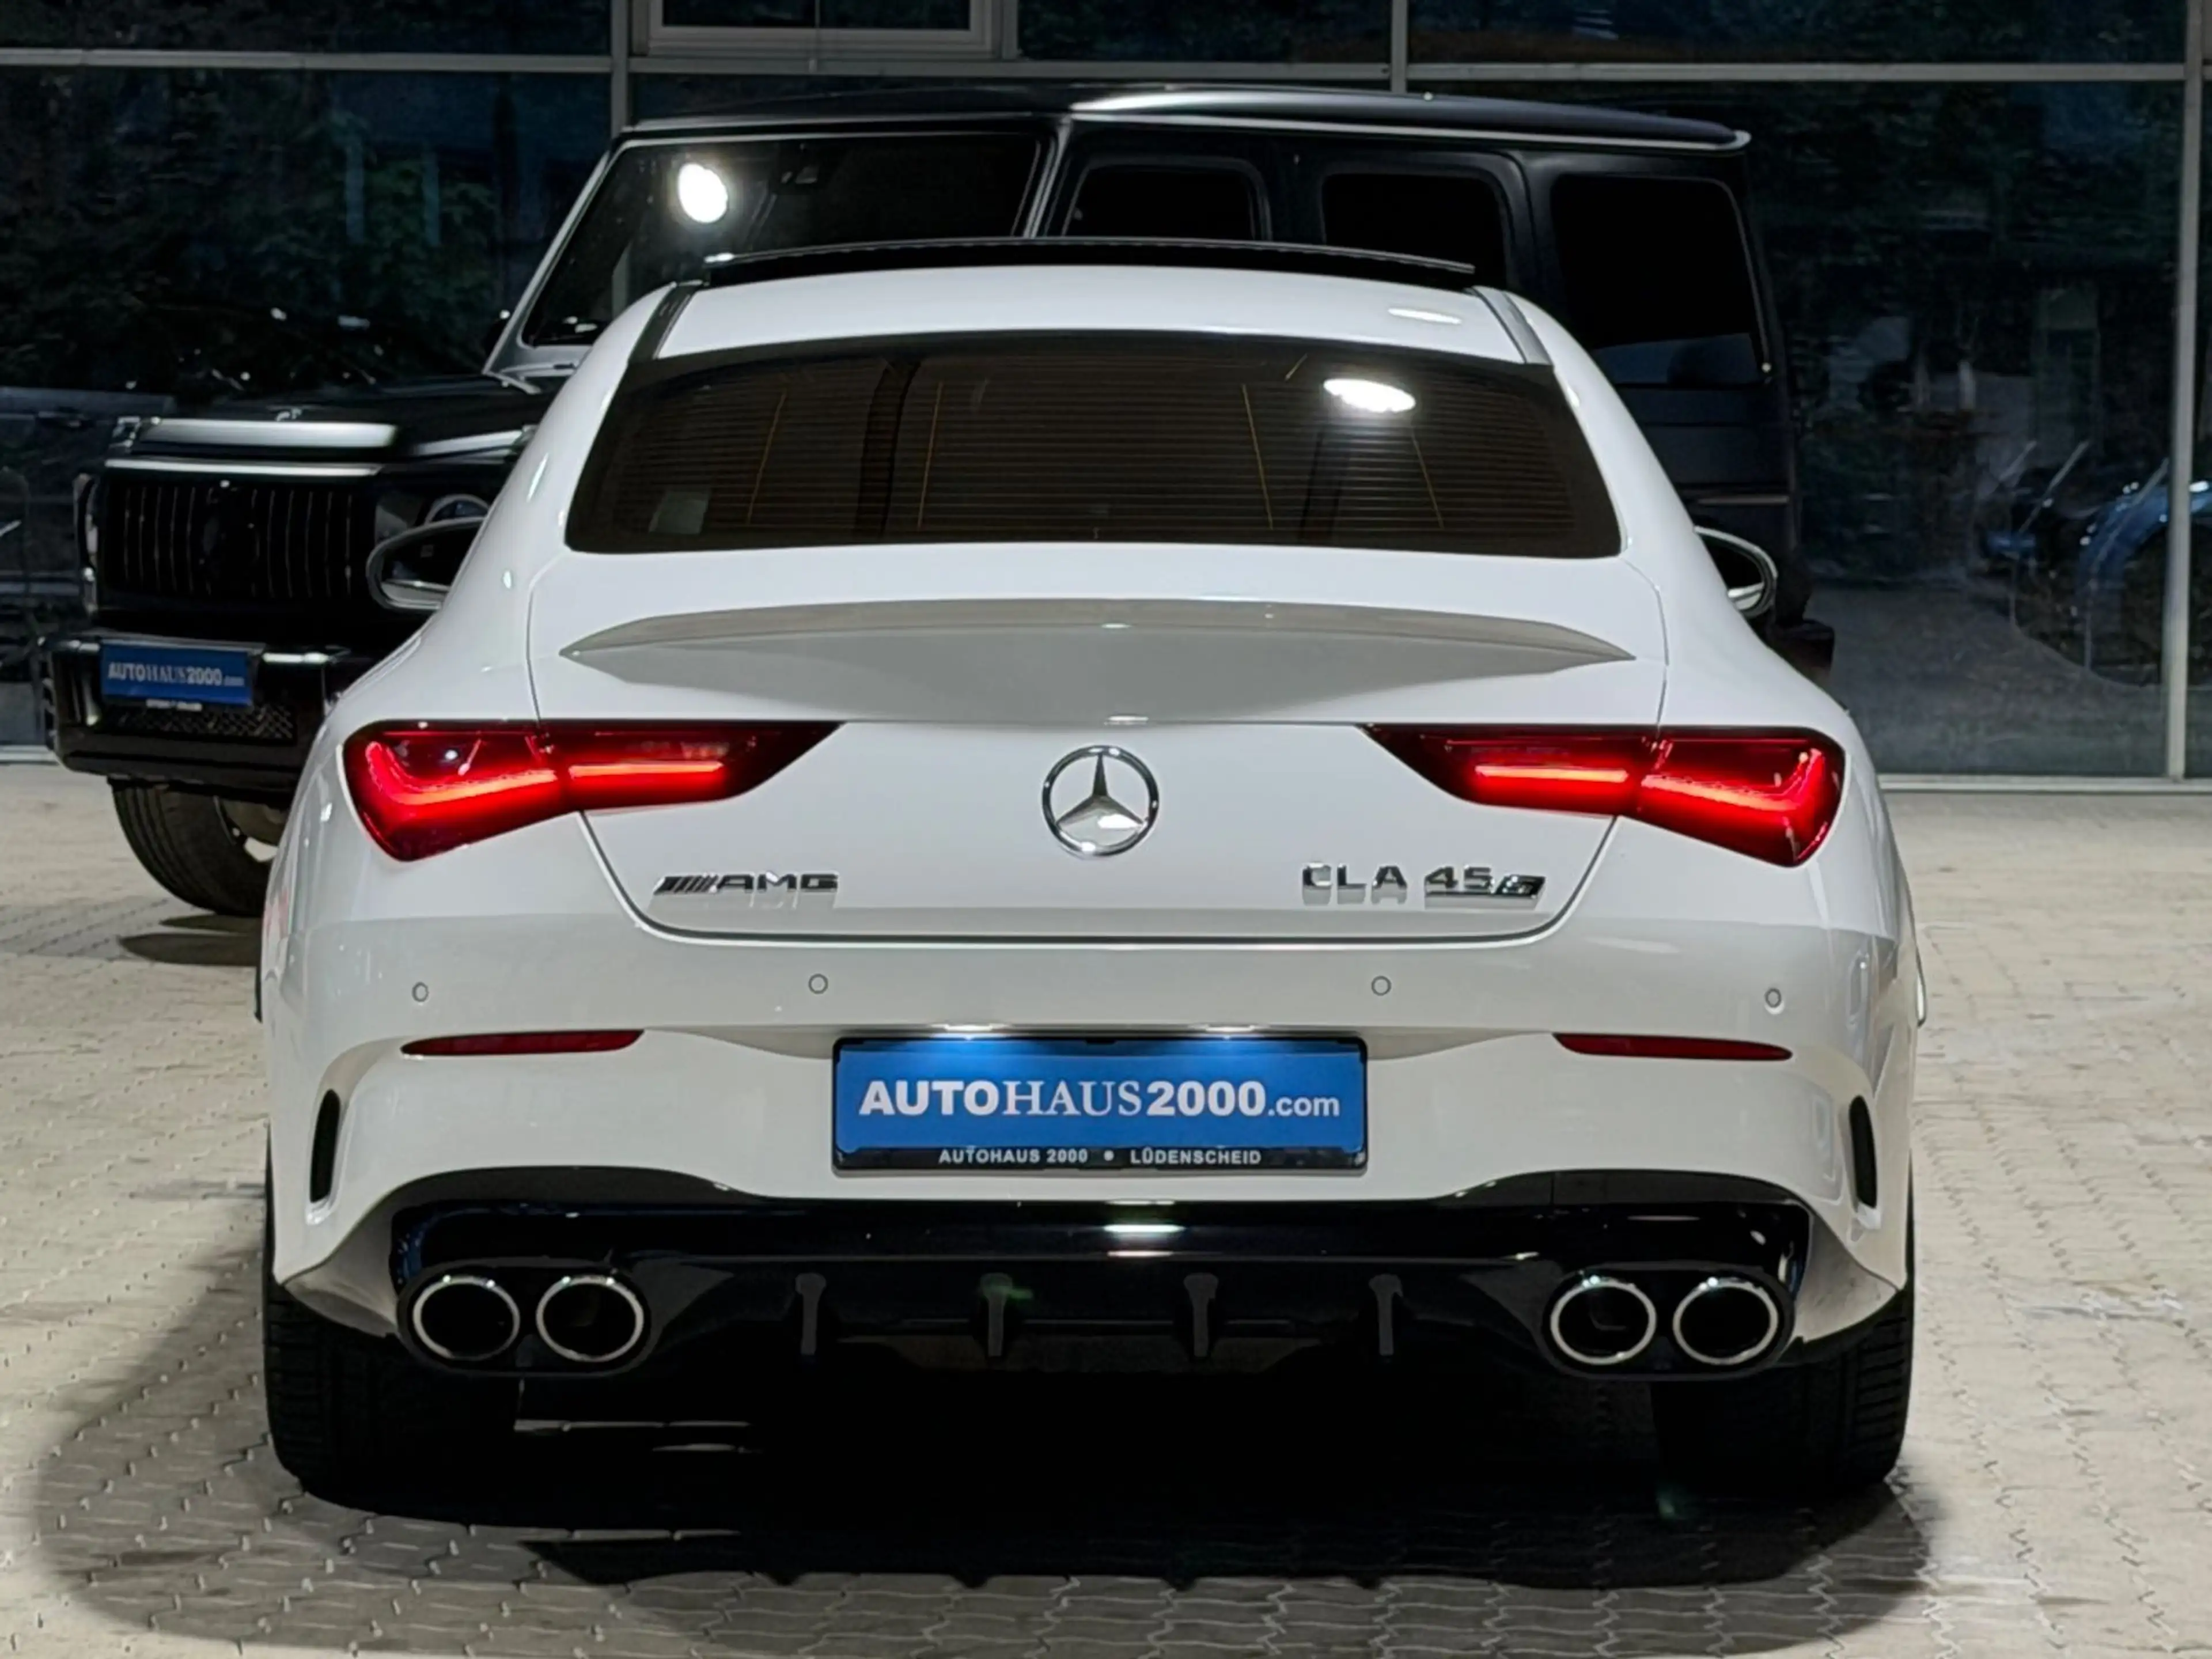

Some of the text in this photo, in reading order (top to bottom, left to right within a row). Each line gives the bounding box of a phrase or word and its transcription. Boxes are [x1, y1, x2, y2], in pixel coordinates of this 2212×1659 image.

[718, 870, 839, 892] AMG
[1302, 863, 1407, 888] CLA
[1424, 865, 1493, 890] 45
[858, 1080, 1340, 1118] AUTOHAUS2000.com
[939, 1147, 1262, 1165] AUTOHAUS 2000 LÜDENSCHEID
